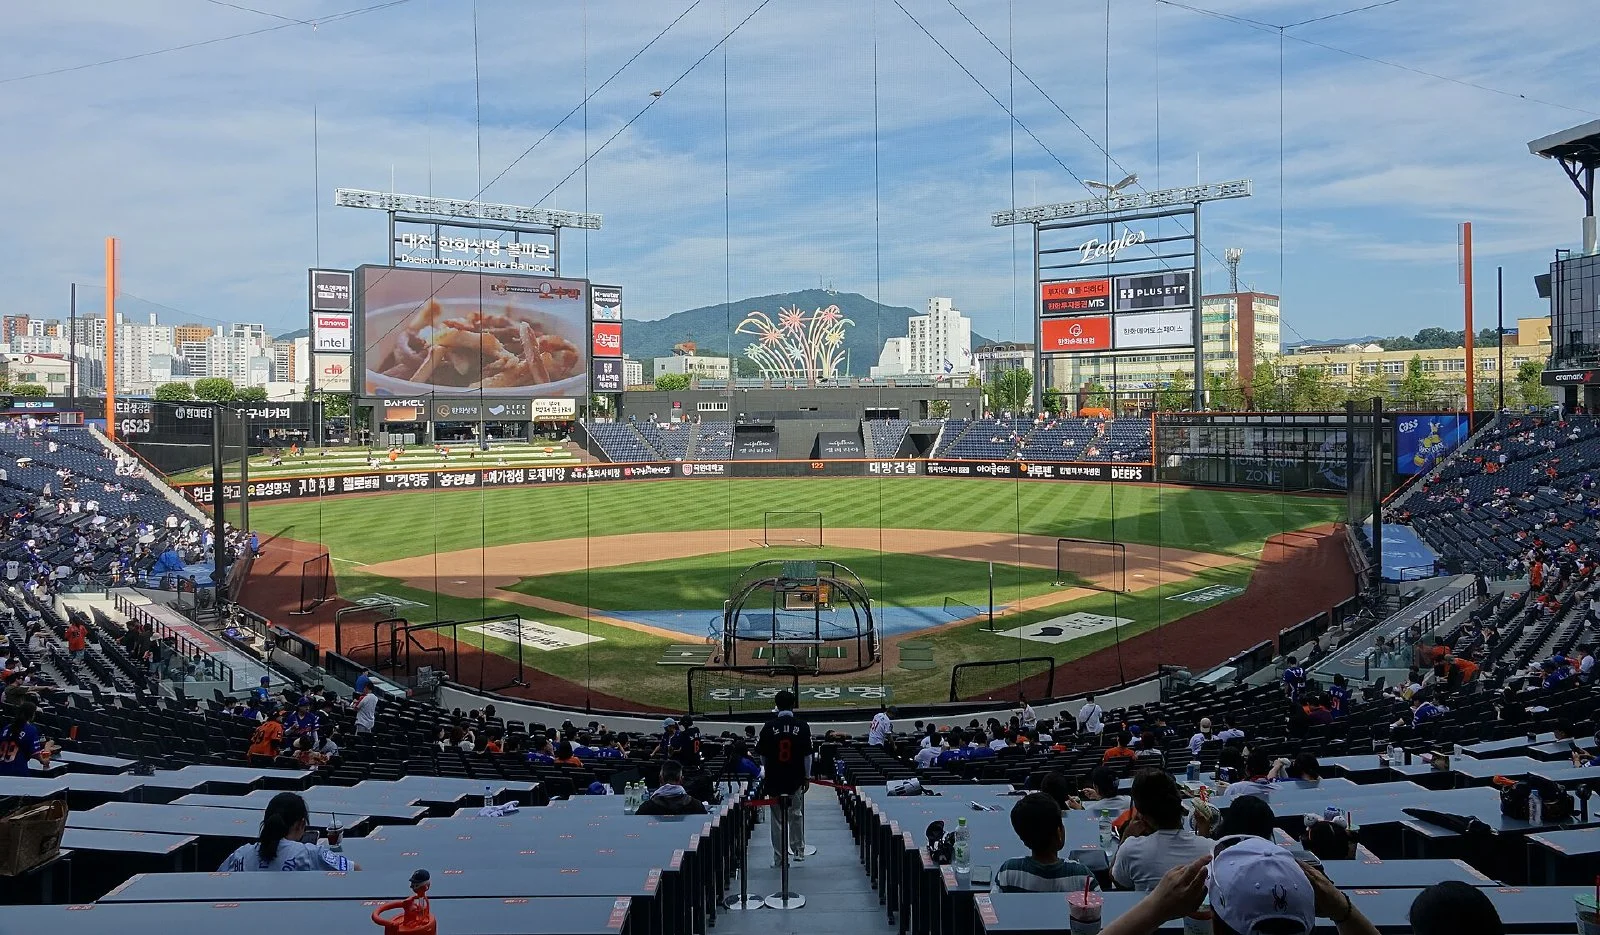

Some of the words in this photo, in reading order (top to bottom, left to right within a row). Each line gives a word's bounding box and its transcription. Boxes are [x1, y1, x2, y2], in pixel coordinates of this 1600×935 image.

[402, 233, 432, 250] 대전
[438, 236, 501, 255] 한화생명
[506, 242, 550, 258] 볼파크
[1079, 228, 1147, 263] Eagles
[402, 253, 439, 265] Daejeon
[1137, 287, 1162, 297] PLUS
[1165, 286, 1185, 294] ETF
[320, 337, 345, 348] intel
[121, 419, 150, 433] GS25
[869, 462, 916, 474] 대방건설
[1111, 469, 1142, 480] DEEPS
[489, 469, 524, 484] 예가정성
[528, 468, 565, 482] 로제비앙
[194, 485, 241, 502] 한남학교
[256, 482, 291, 496] 음성명작
[779, 738, 792, 761] 8
